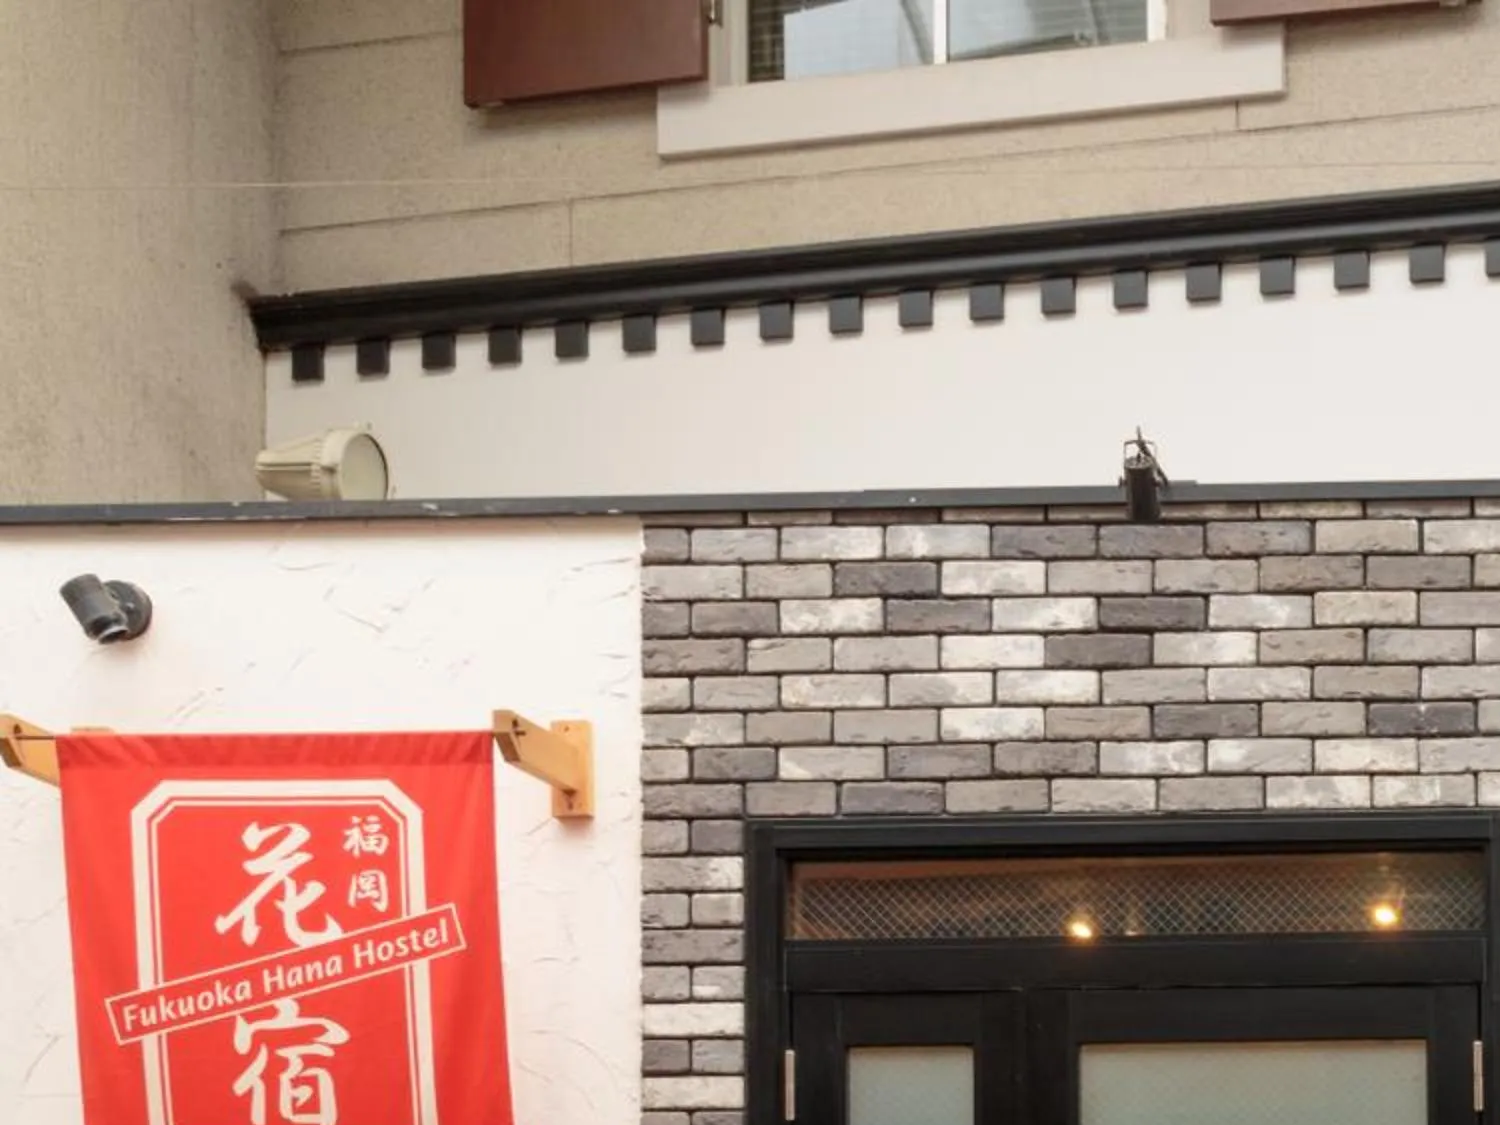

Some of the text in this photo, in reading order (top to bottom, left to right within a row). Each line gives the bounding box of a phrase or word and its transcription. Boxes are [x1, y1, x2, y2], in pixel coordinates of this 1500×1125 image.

[343, 815, 390, 912] 福岡
[122, 918, 449, 1031] Fukuoka Hana Hostel
